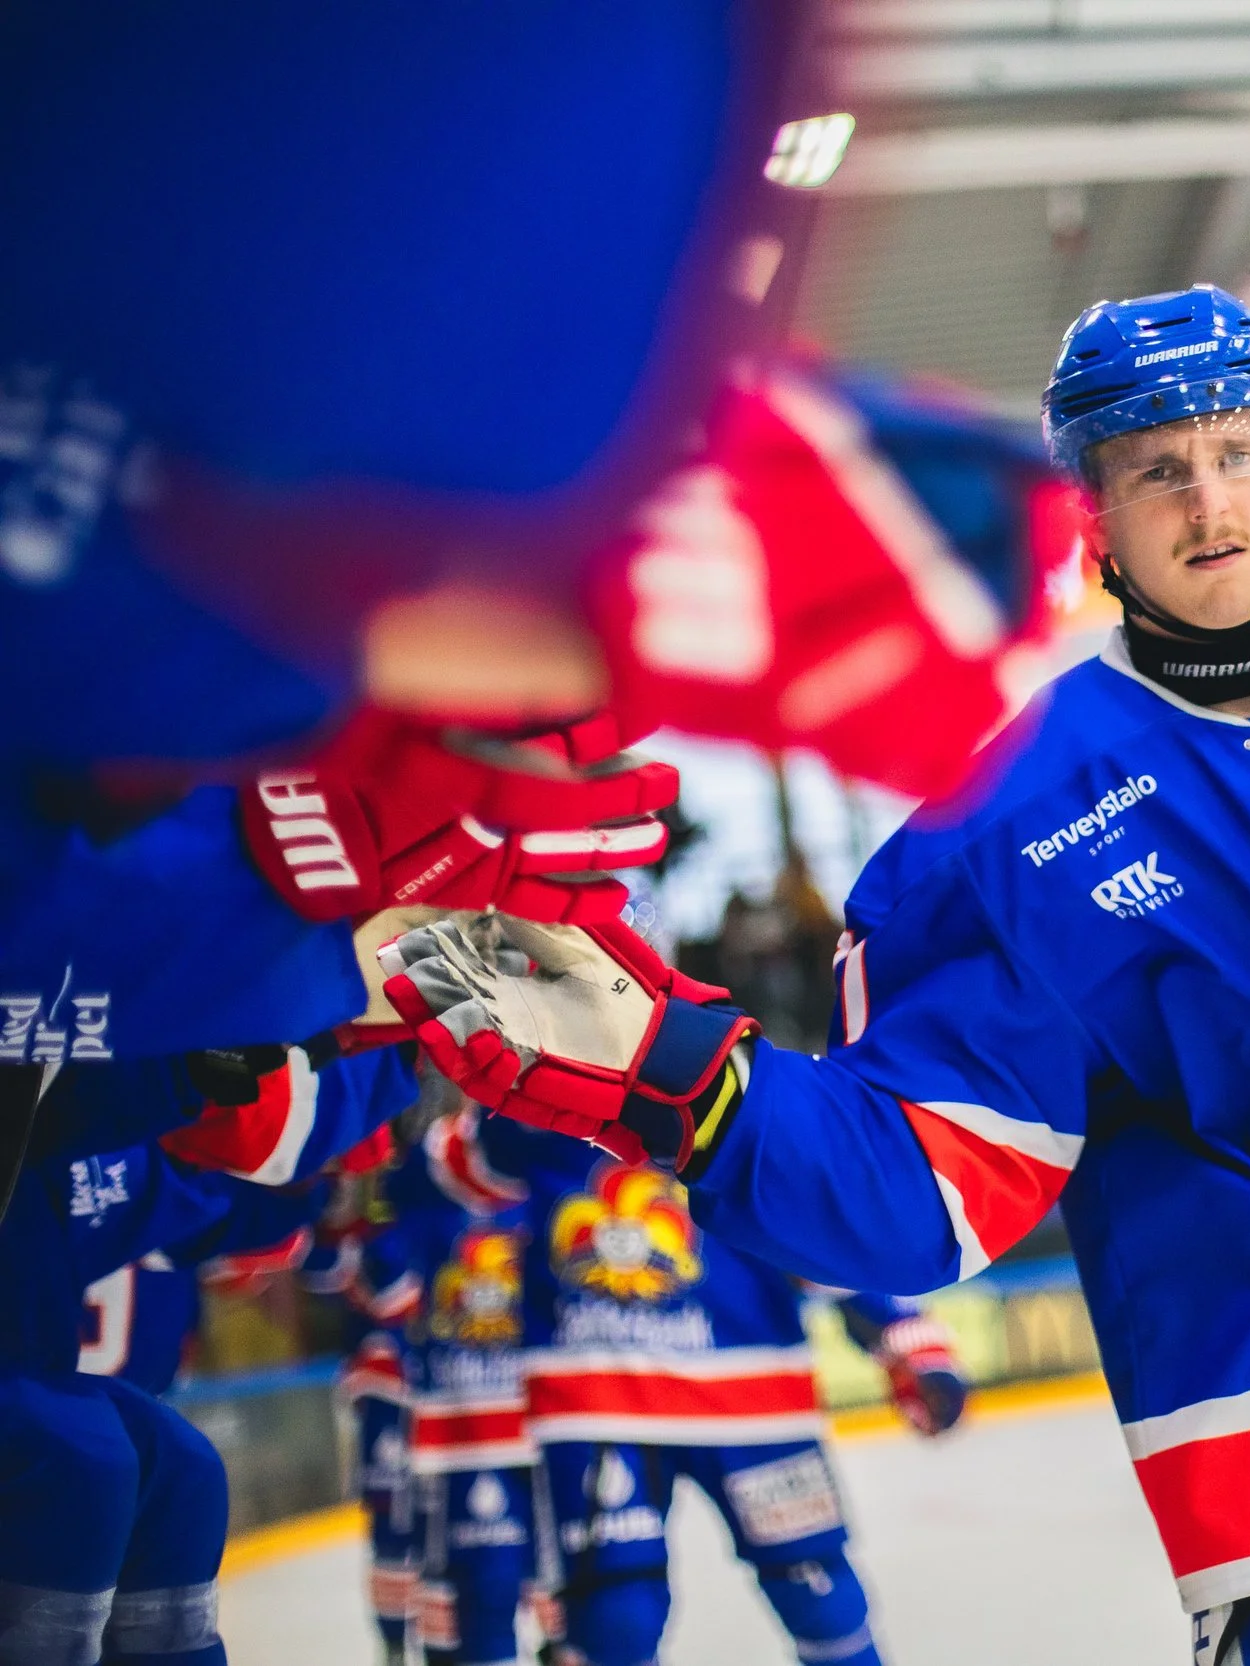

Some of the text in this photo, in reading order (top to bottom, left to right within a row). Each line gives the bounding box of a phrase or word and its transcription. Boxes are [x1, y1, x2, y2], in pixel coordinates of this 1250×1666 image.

[1134, 340, 1219, 368] WARRIOR
[1021, 775, 1158, 868] Terveystalo
[1088, 826, 1126, 857] SPORT
[394, 854, 454, 901] COVERT
[1090, 851, 1177, 912] RTK
[610, 977, 630, 995] 51
